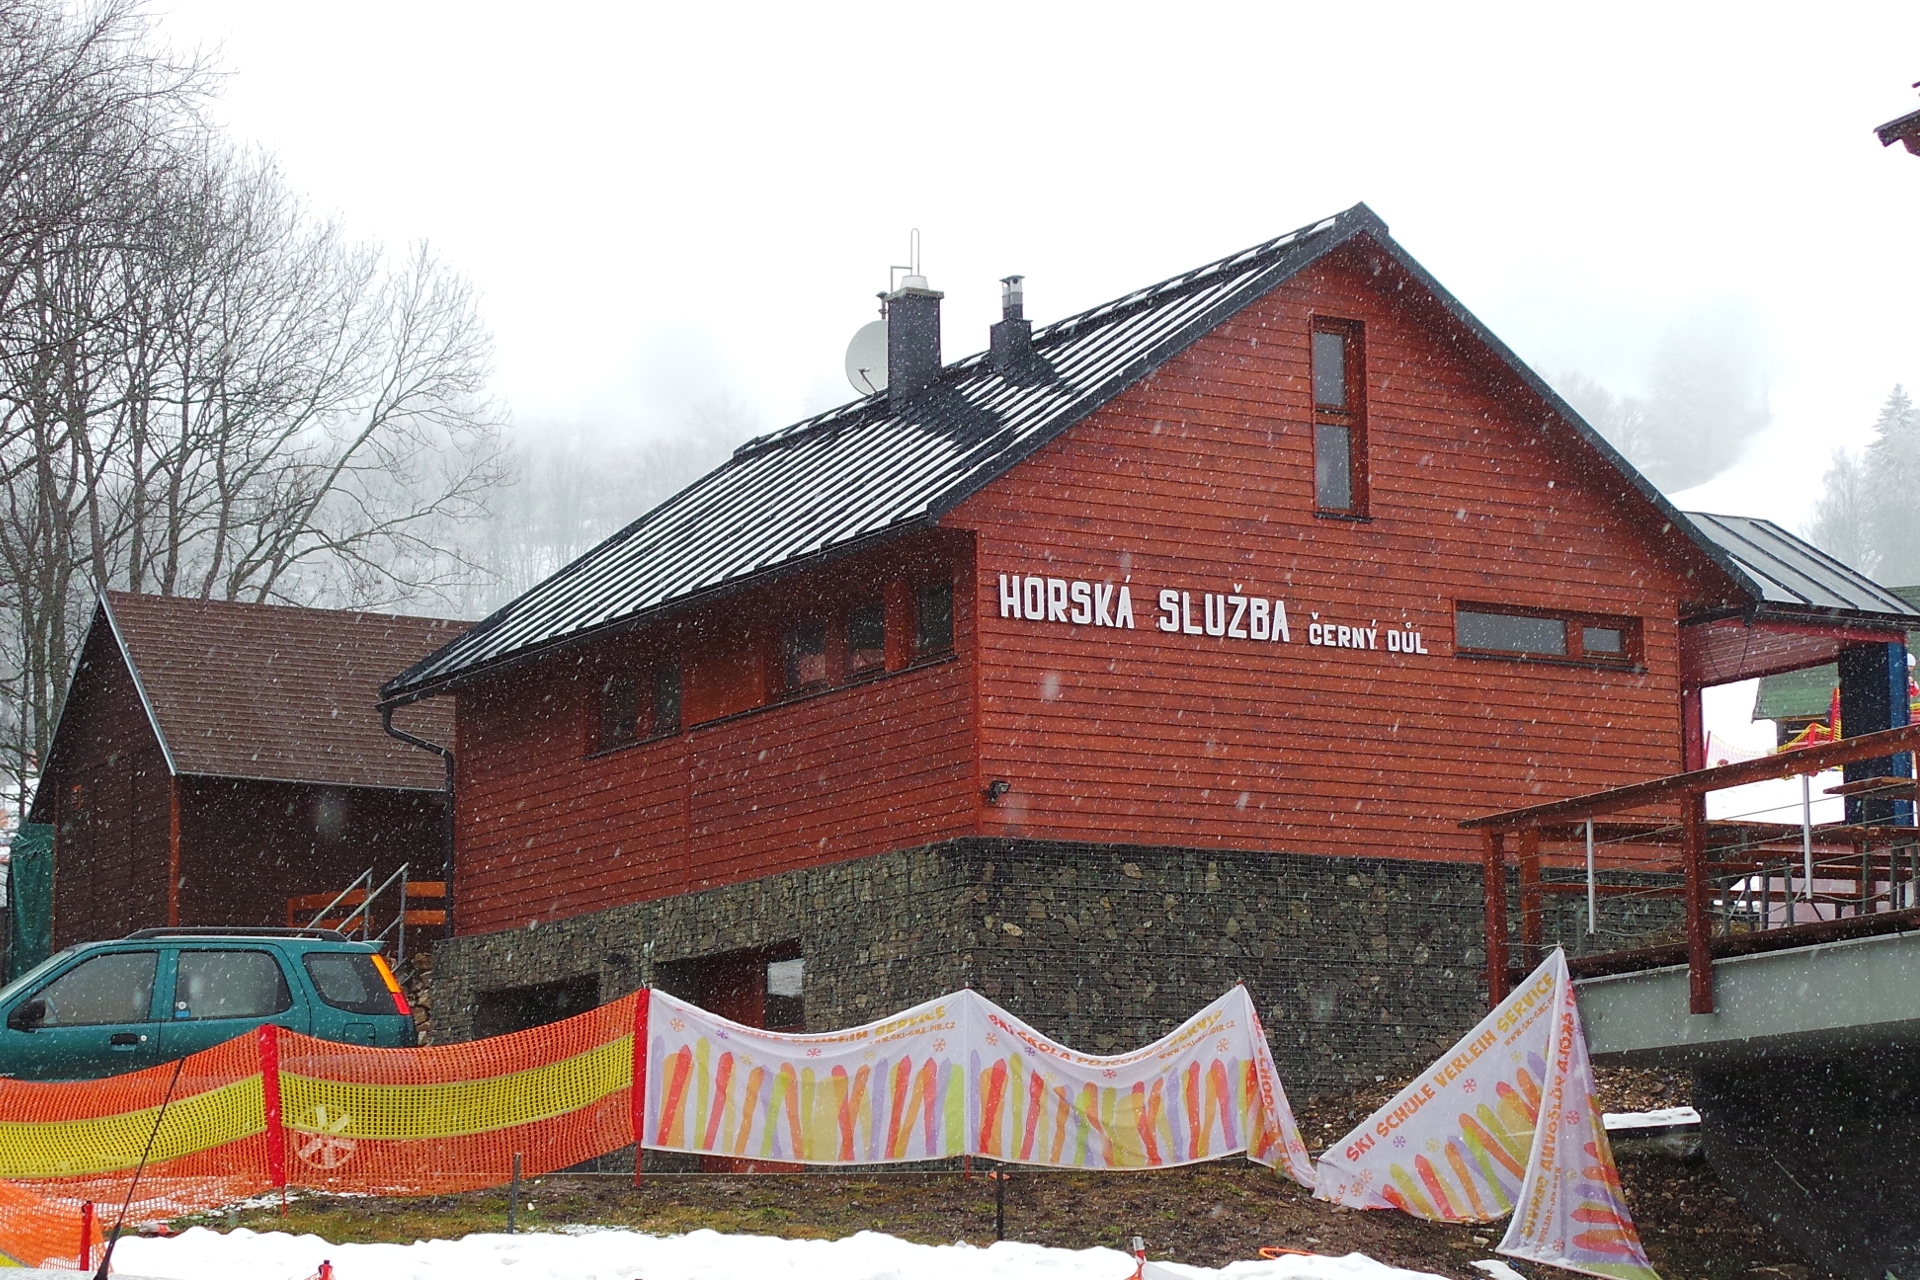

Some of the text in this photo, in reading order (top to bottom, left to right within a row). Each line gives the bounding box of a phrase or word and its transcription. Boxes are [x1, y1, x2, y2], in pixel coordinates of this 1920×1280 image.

[1000, 574, 1429, 655] HORSKÁ SLUŽBA ČERNÝ DŮL
[1345, 1132, 1376, 1163] SKI
[1376, 1083, 1437, 1139] SCHULE
[1433, 1028, 1498, 1089] VERLEIH
[1496, 972, 1555, 1034] SERVICE
